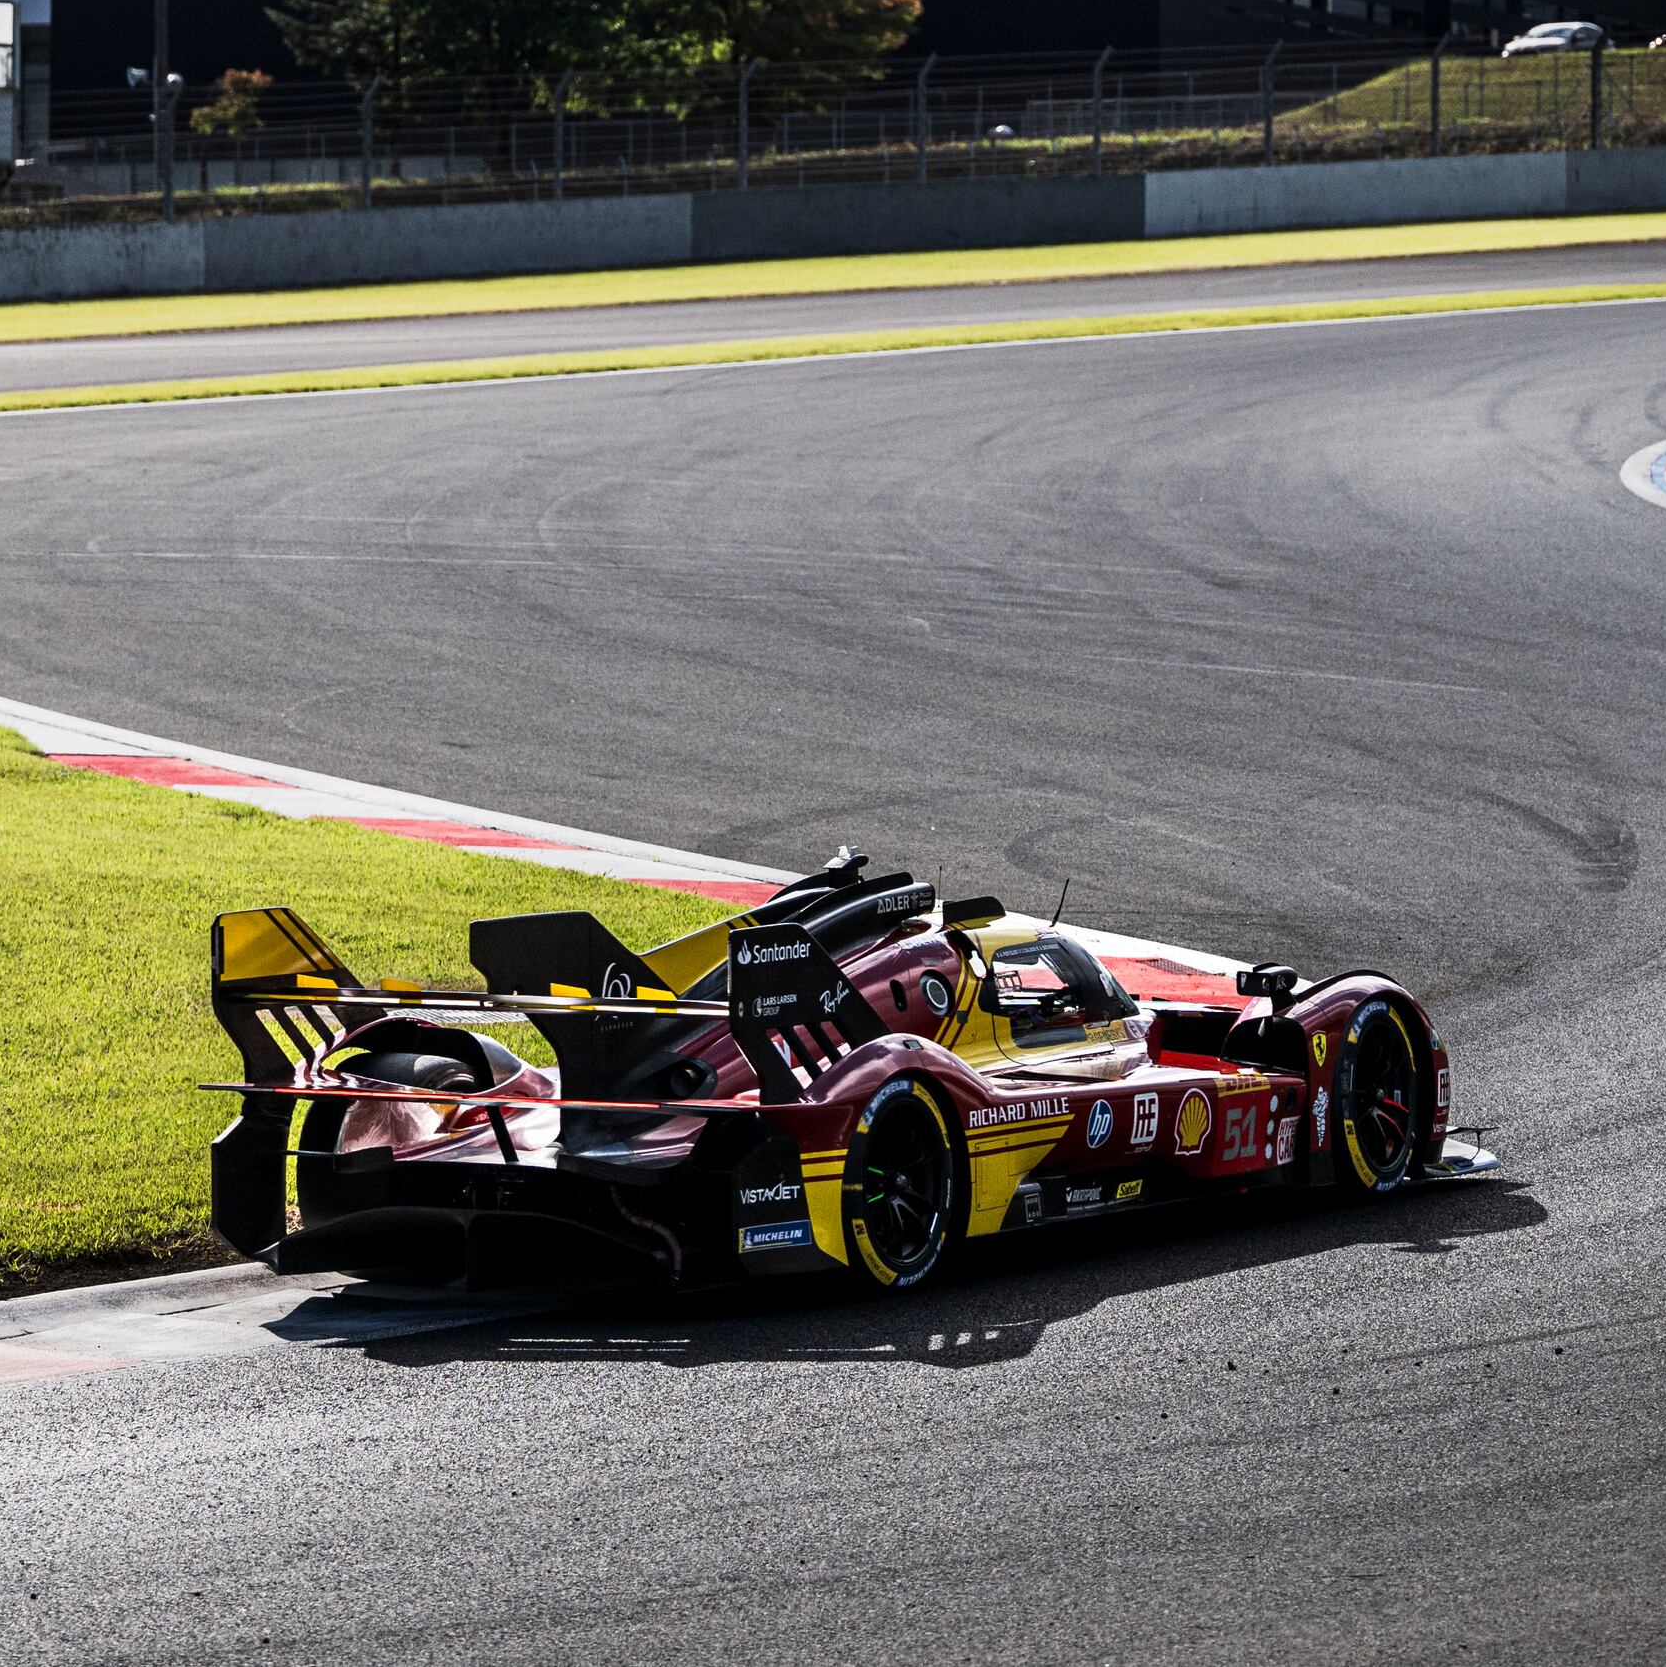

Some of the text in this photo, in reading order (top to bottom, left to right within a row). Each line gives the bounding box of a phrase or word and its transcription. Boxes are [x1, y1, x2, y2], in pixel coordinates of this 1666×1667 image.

[877, 895, 910, 914] ADLER
[753, 940, 811, 964] Santander
[763, 994, 797, 1006] LARS LARSEN
[763, 1006, 780, 1017] GROUP
[969, 1097, 1070, 1128] RICHARD MILLE
[1089, 1102, 1111, 1146] hp
[1222, 1105, 1258, 1161] 51
[753, 1229, 803, 1243] MICHELIN
